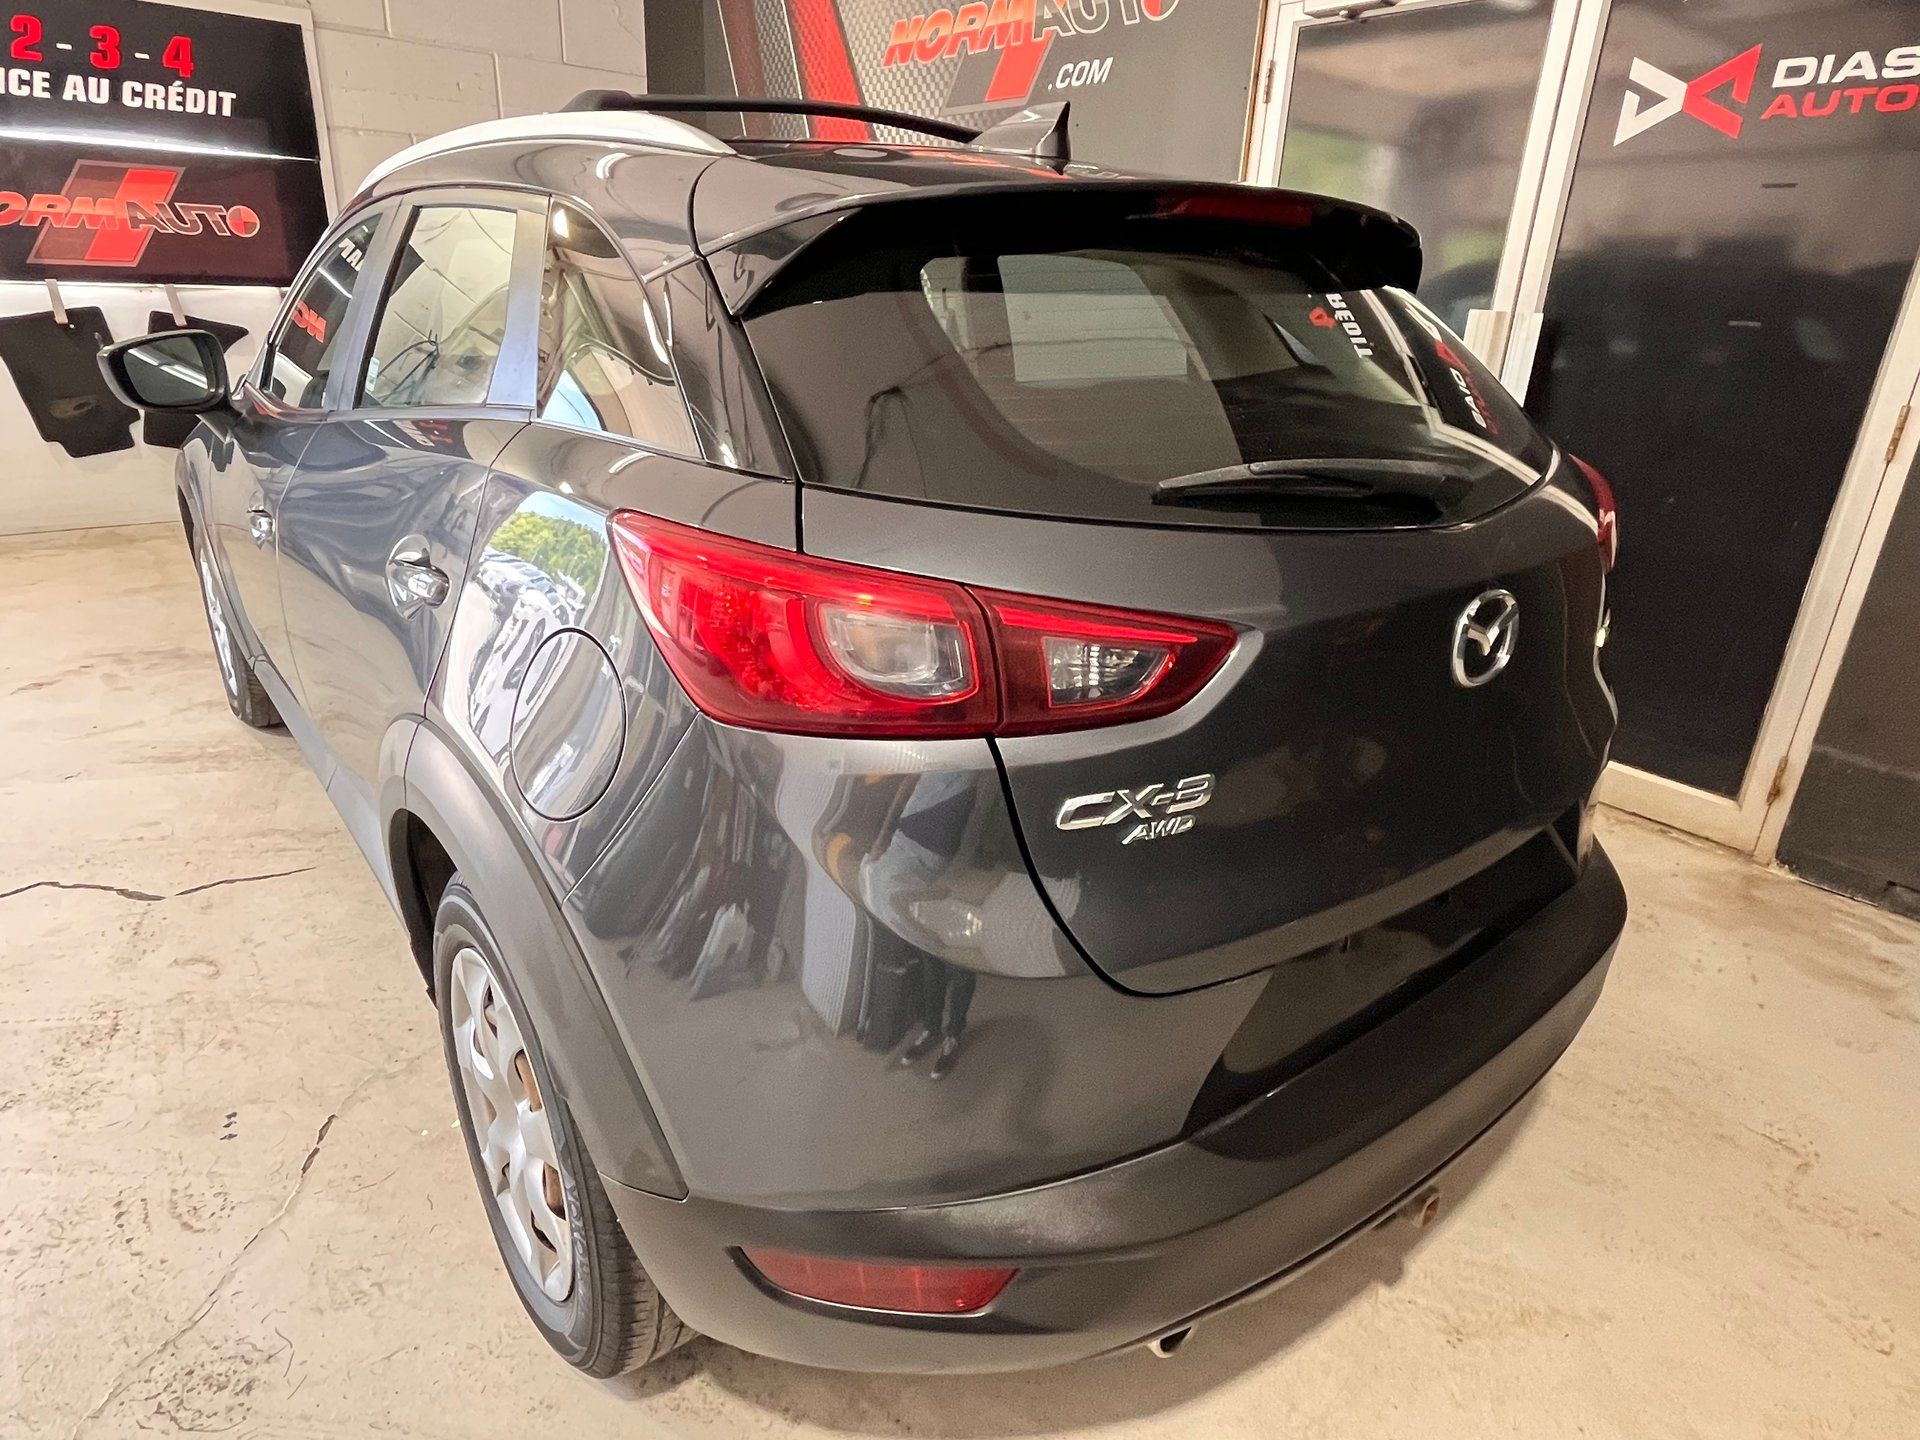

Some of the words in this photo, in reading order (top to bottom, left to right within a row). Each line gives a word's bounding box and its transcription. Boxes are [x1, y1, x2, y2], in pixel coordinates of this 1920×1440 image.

[10, 14, 43, 61] 2
[89, 25, 121, 70] 3
[162, 35, 195, 78] 4
[1772, 46, 1920, 88] DIAS
[1048, 57, 1114, 90] .COM
[62, 75, 110, 104] AU
[122, 81, 237, 117] CRÉDIT
[1056, 773, 1215, 831] CX-3
[1121, 814, 1197, 845] AWD
